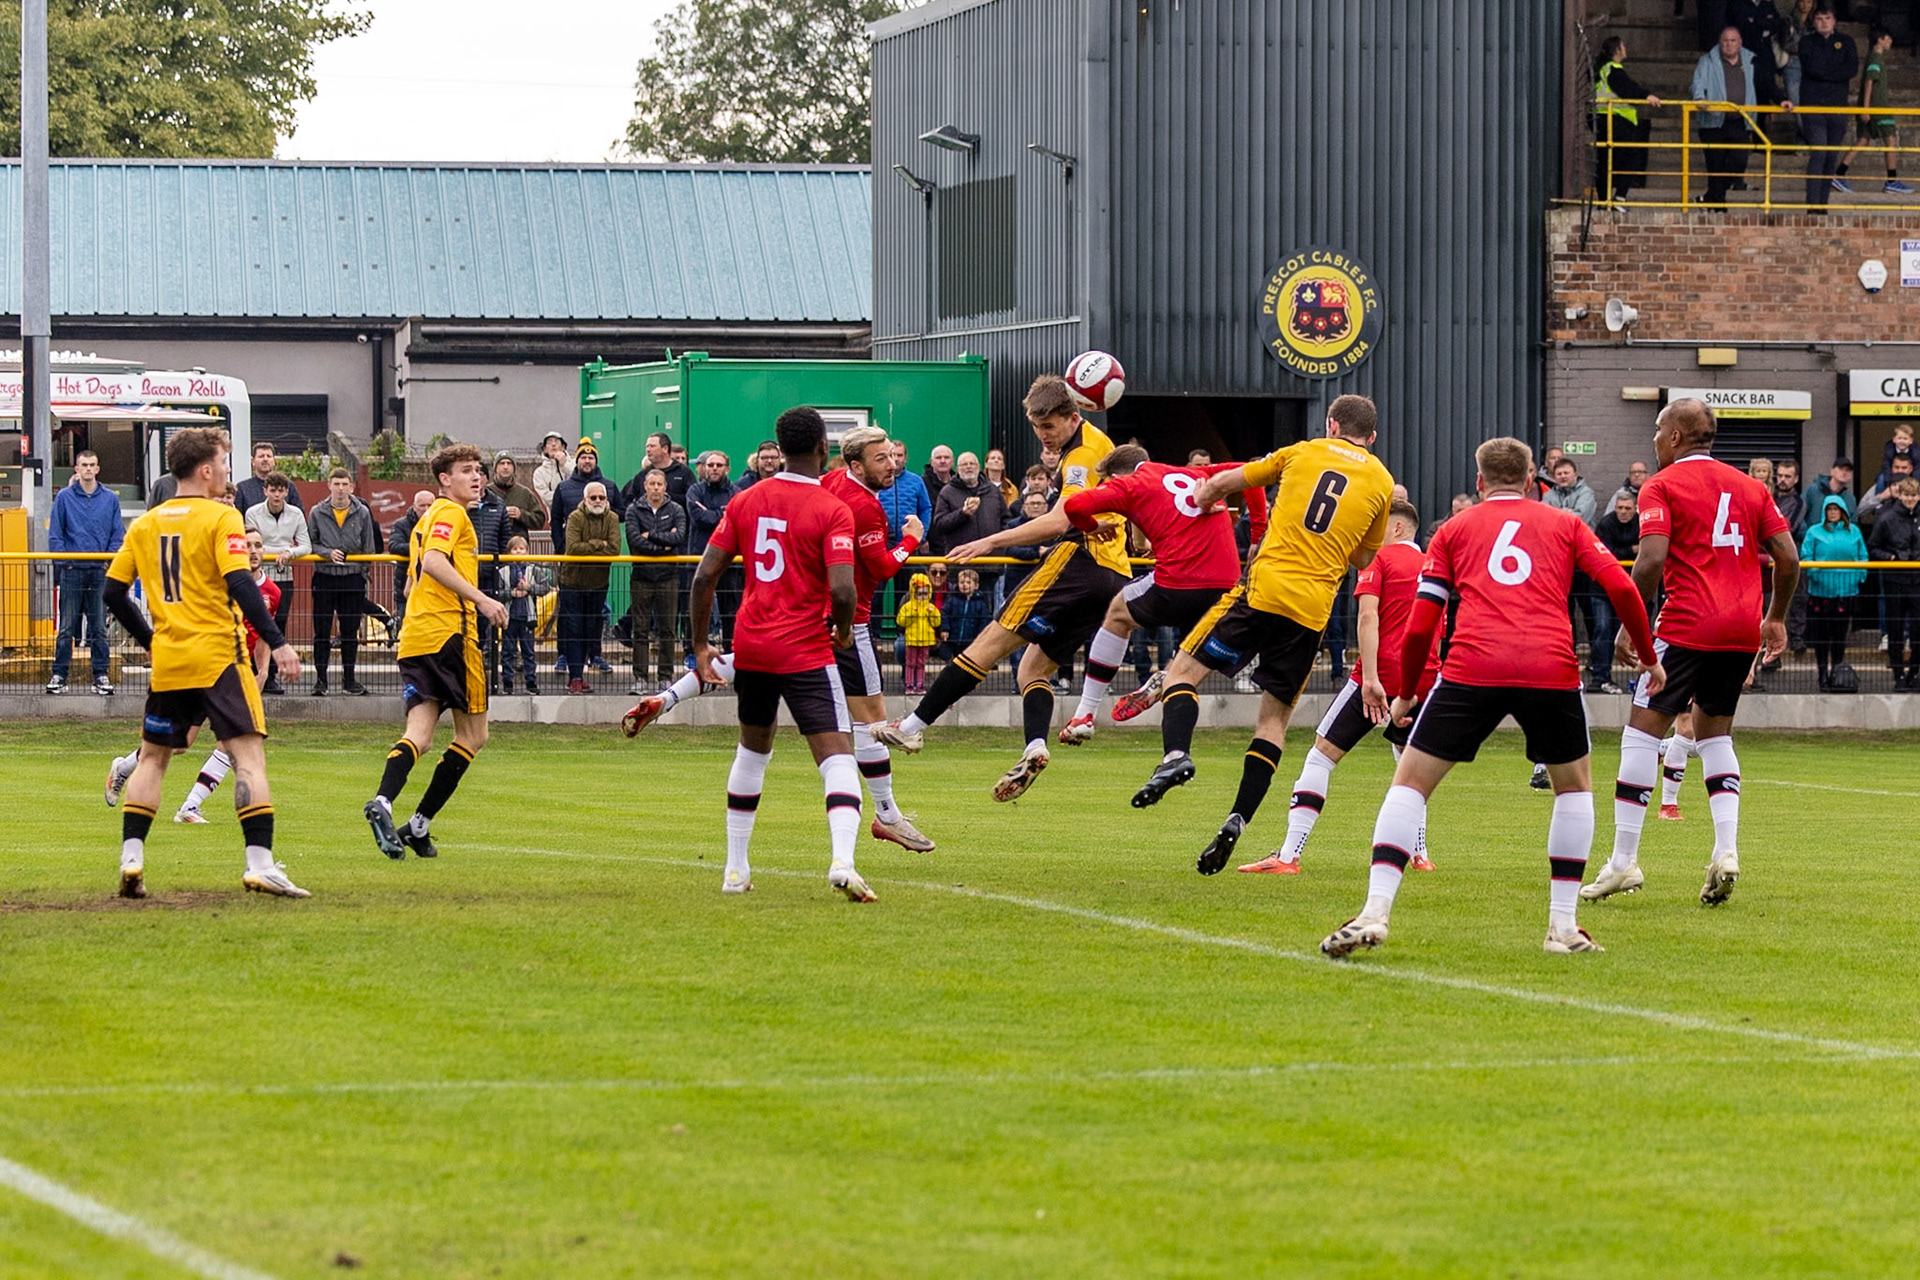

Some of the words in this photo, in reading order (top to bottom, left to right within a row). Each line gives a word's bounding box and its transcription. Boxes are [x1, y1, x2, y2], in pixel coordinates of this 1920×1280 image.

[1263, 254, 1306, 315] PRESCOT
[1311, 251, 1367, 285] CABLES
[57, 376, 81, 396] Hot
[85, 377, 122, 399] Dogs
[141, 378, 182, 396] Bacon
[188, 378, 226, 397] Rolls
[1271, 339, 1338, 374] FOUNDED
[1342, 341, 1369, 367] 1884
[1705, 392, 1747, 405] SNACK
[1749, 394, 1775, 405] BAR
[1162, 472, 1203, 518] 8
[1303, 468, 1349, 535] 6
[1711, 491, 1744, 556] 4
[160, 534, 182, 603] 11
[754, 516, 788, 583] 5
[1487, 519, 1532, 586] 6
